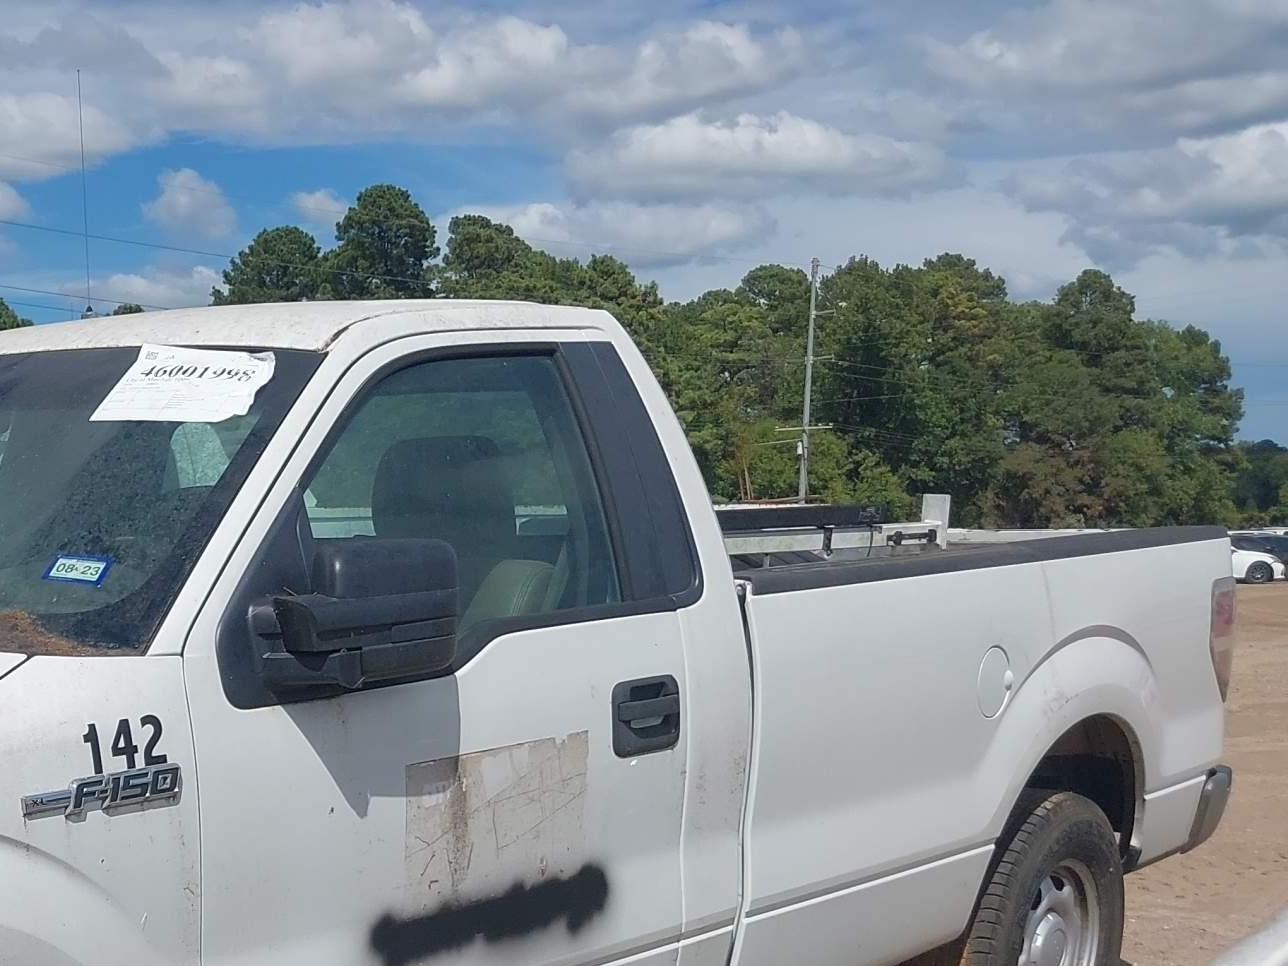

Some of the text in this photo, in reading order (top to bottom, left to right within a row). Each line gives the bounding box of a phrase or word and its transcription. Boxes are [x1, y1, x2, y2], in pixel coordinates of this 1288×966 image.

[140, 364, 257, 383] 46001998
[55, 562, 101, 577] 08 23
[82, 714, 168, 775] 142
